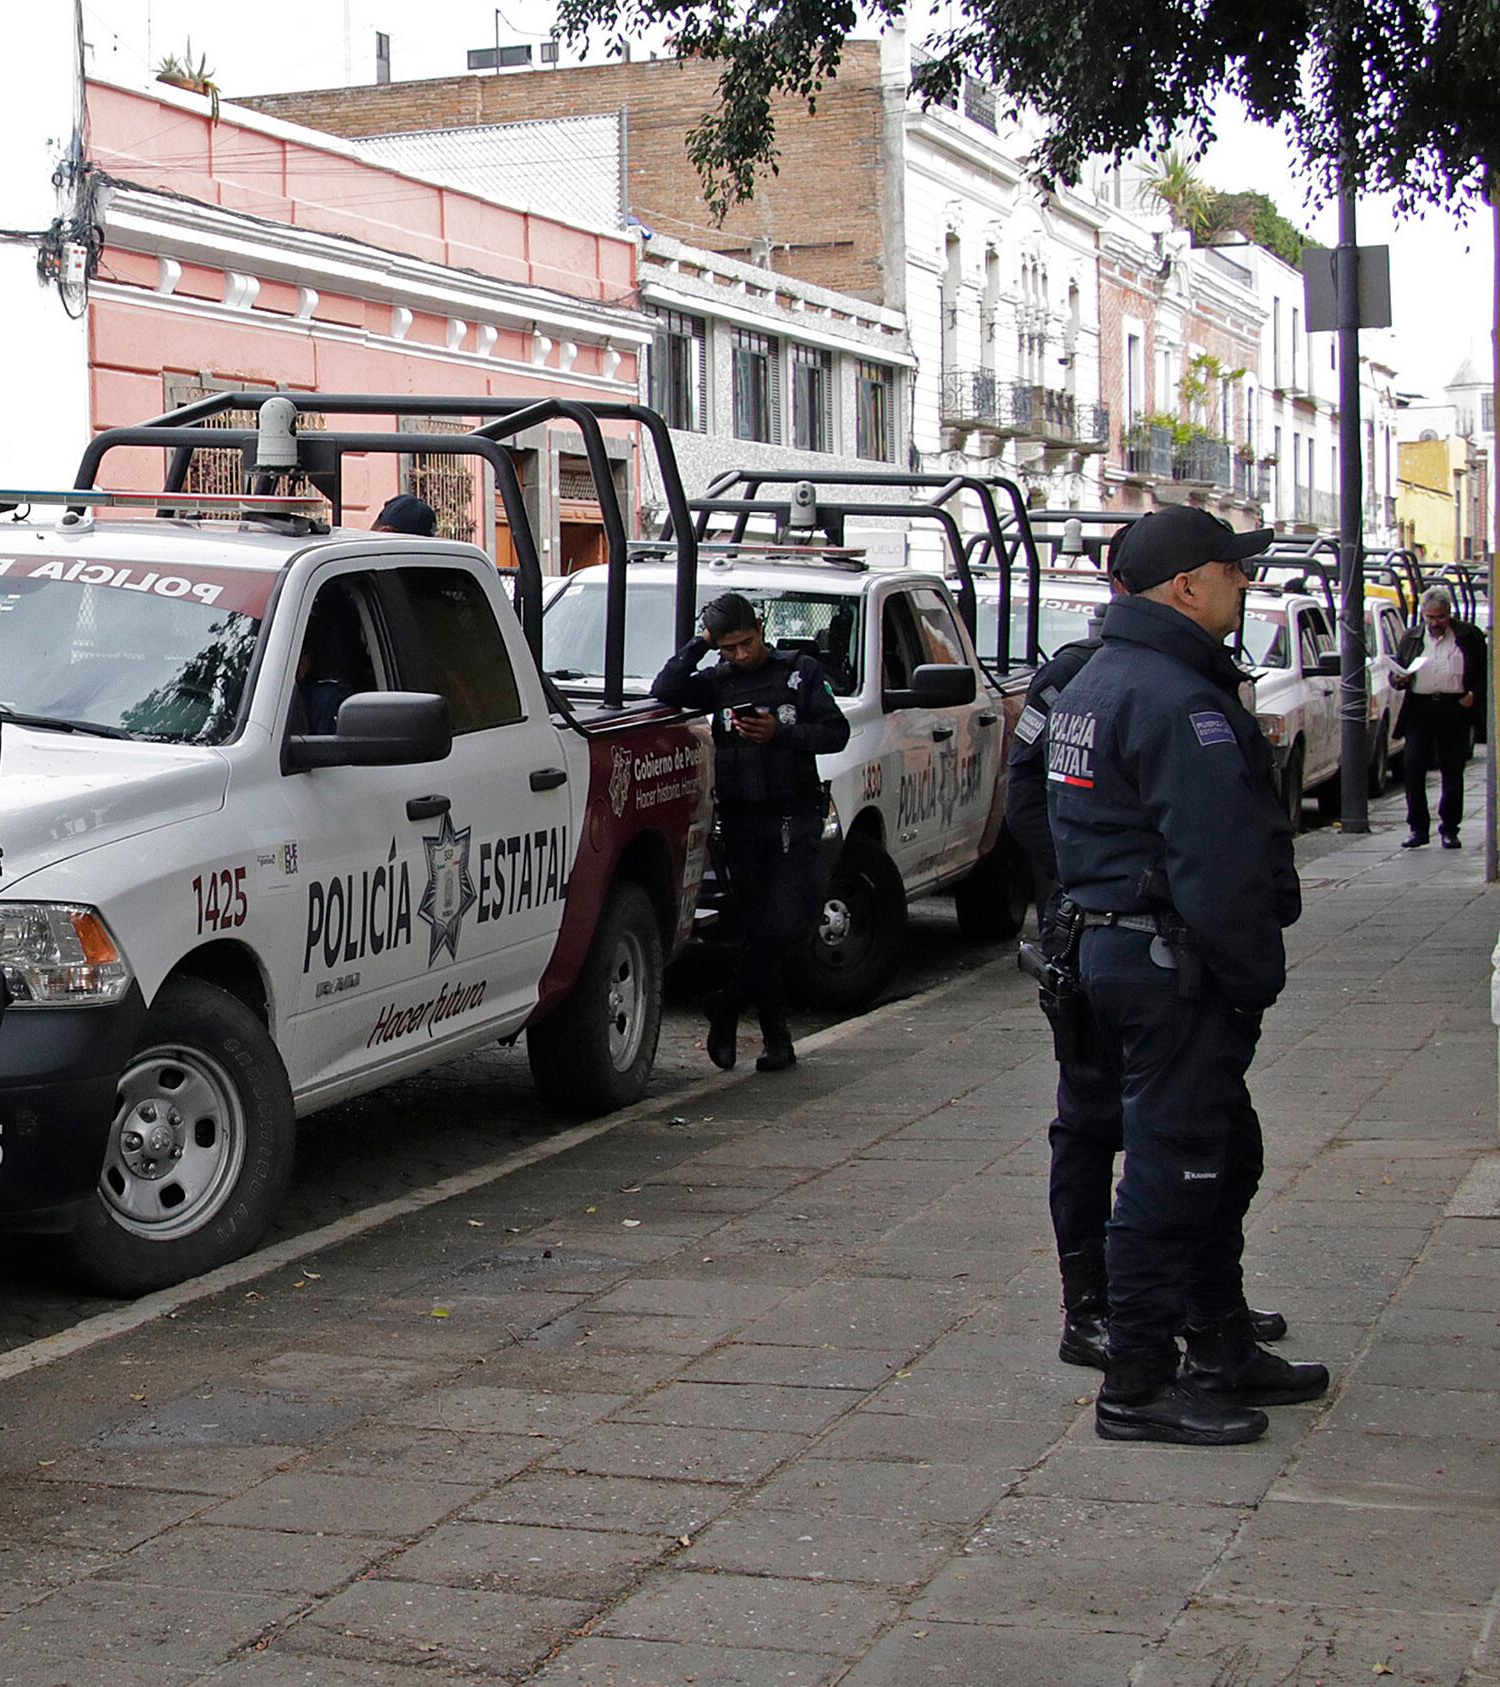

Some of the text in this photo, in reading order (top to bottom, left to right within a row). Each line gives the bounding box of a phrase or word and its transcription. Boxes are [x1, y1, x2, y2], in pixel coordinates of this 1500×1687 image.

[192, 866, 248, 934] 1425
[303, 825, 569, 973] POLICÍA ESTATAL
[366, 1002, 437, 1048] Hacer
